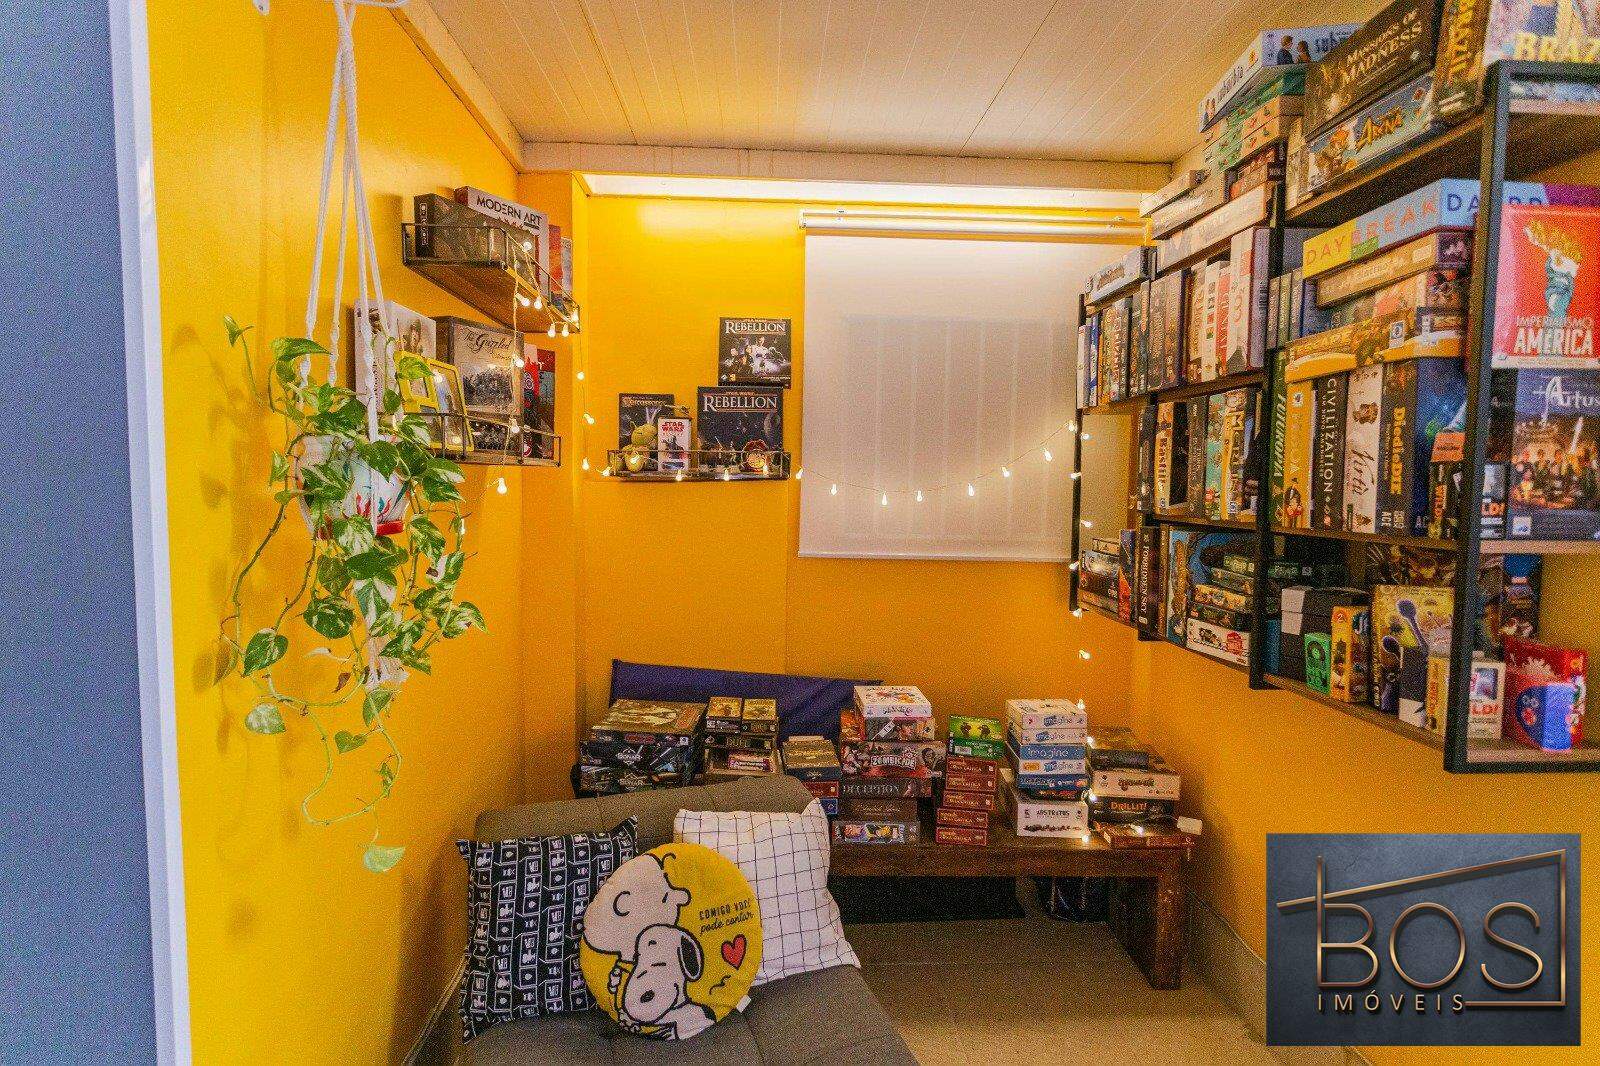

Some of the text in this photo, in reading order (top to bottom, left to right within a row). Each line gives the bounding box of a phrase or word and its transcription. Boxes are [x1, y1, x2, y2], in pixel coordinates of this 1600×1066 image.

[1341, 20, 1424, 86] MADNESS
[476, 195, 543, 226] MODERN ART
[724, 321, 786, 335] REBELLION
[703, 395, 778, 412] REBELLION
[661, 425, 685, 433] WARS
[1273, 394, 1287, 478] FUTUROPIA
[1323, 377, 1337, 493] CIVILIZATION
[1480, 502, 1506, 516] LD!
[1139, 545, 1150, 614] FORBIDDEN SKY
[1471, 703, 1501, 716] LD!
[1027, 746, 1070, 759] imagine
[870, 754, 917, 770] ZOMBICIDE
[699, 904, 731, 920] COMIGO
[699, 911, 755, 937] pode contar
